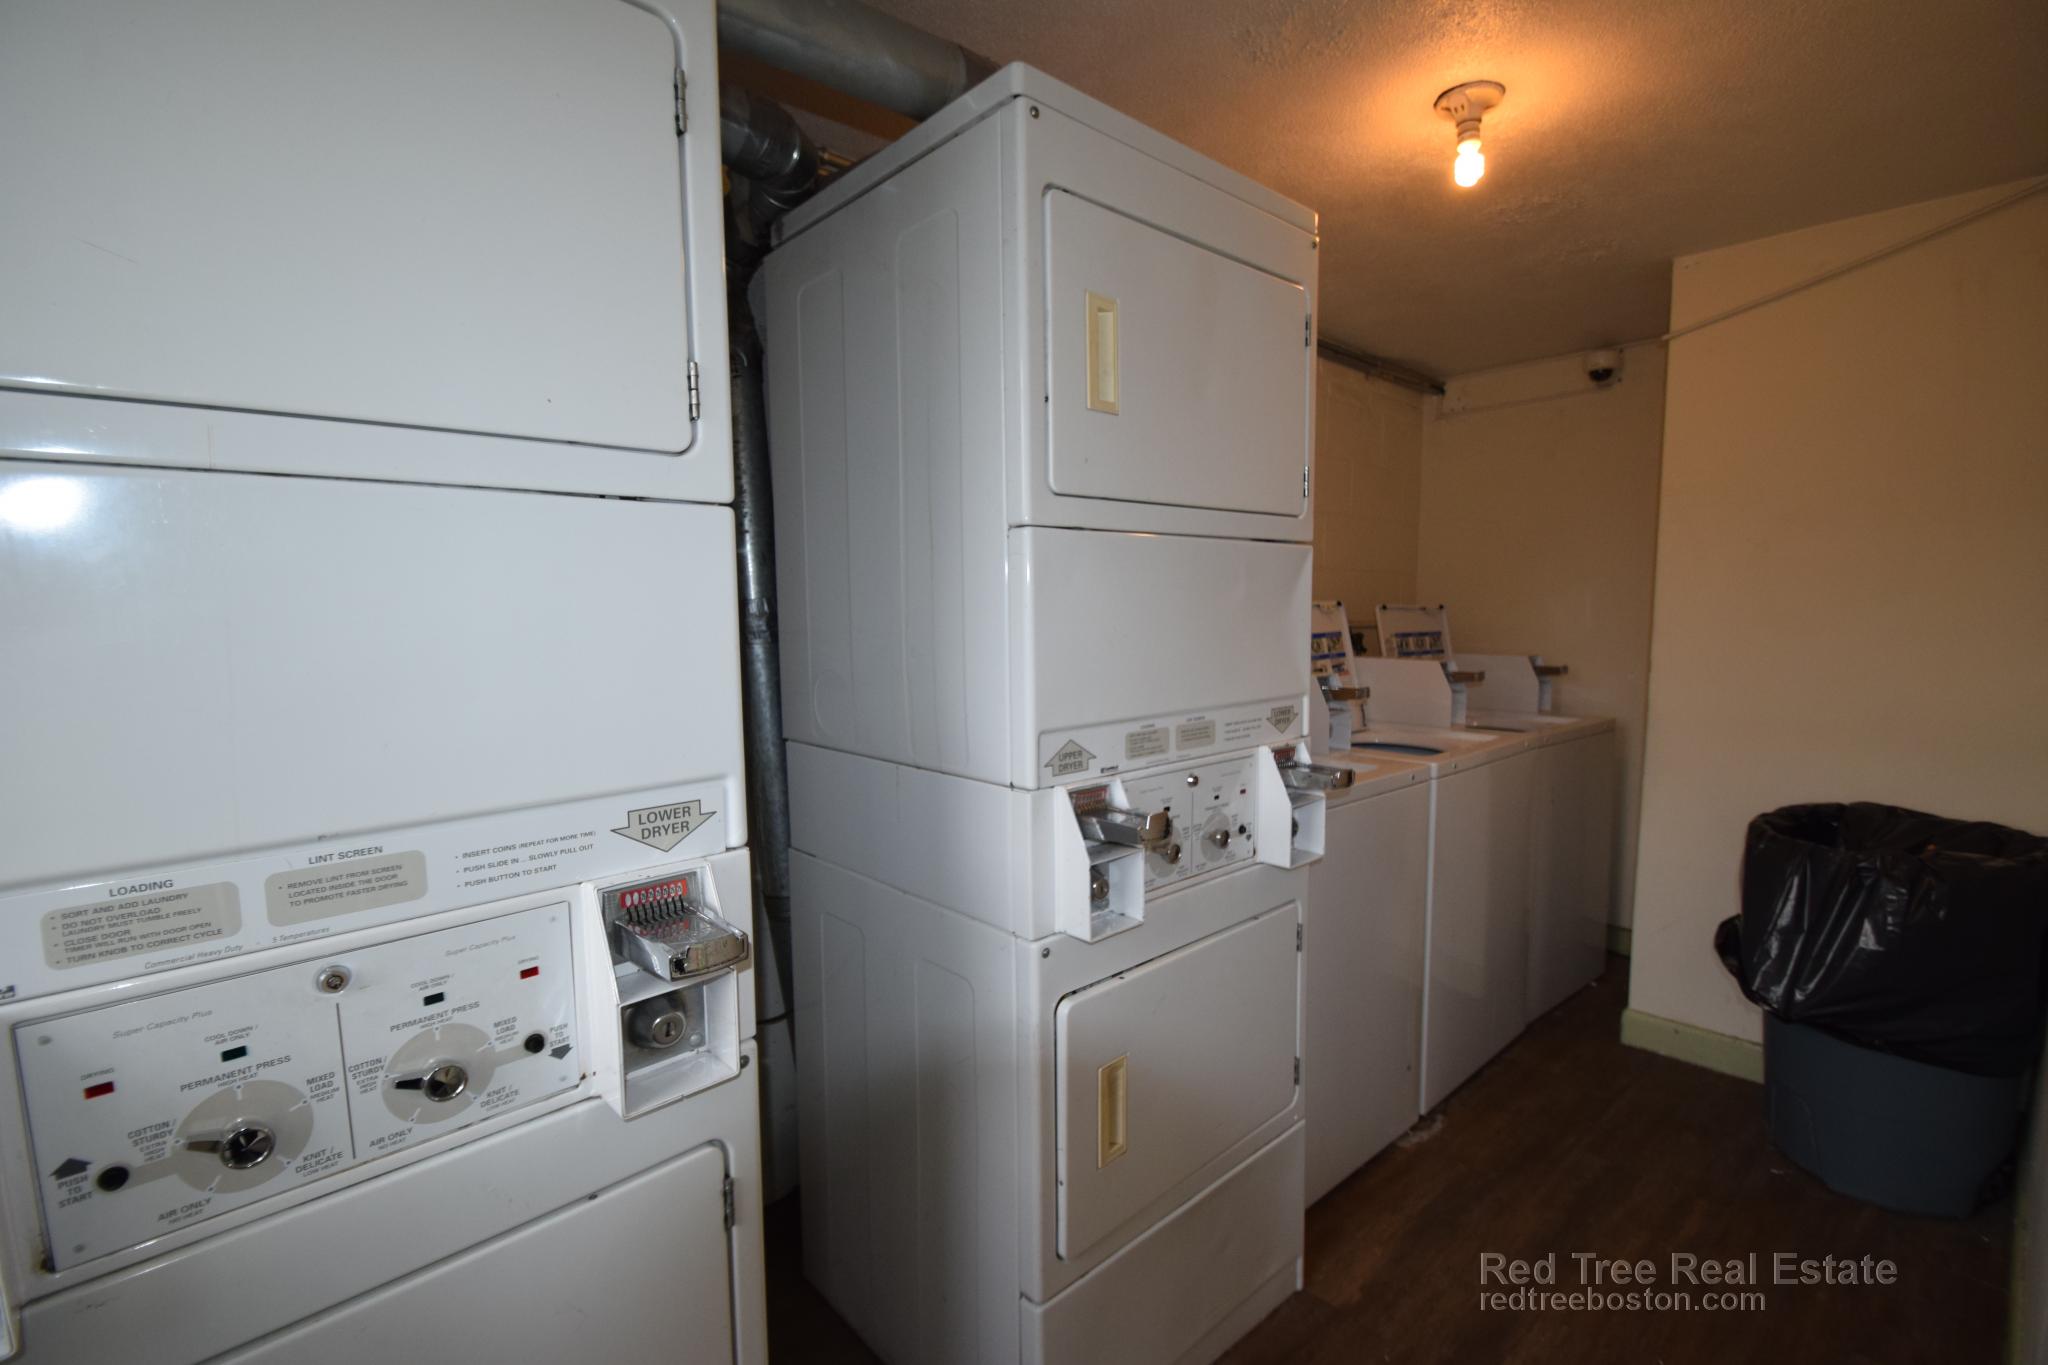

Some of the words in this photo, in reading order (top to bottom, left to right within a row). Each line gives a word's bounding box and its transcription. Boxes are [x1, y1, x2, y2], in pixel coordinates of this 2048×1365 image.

[1059, 751, 1082, 761] UPPER
[1059, 761, 1083, 772] DRYER
[639, 806, 691, 825] LOWER
[641, 821, 690, 840] DRYER
[309, 854, 334, 865] LINT
[338, 846, 383, 860] SCREEN
[462, 849, 490, 858] INSERT
[492, 845, 516, 853] COINS
[464, 864, 485, 873] PUSH
[488, 860, 508, 868] SLIDE
[288, 878, 323, 889] REMOVE
[325, 875, 344, 883] LINT
[346, 870, 369, 879] FROM
[371, 865, 402, 874] SCREEN
[465, 878, 486, 887] PUSH
[489, 872, 520, 882] BUTTON
[535, 865, 556, 874] START
[109, 880, 173, 897] LOADING
[289, 887, 326, 898] LOCATED
[329, 882, 355, 891] INSIDE
[375, 874, 398, 883] DOOR
[304, 893, 344, 904] PROMOTE
[346, 887, 376, 896] FASTER
[378, 881, 408, 891] DRYING
[61, 909, 88, 920] SORT
[93, 905, 114, 915] AND
[118, 901, 138, 910] ADD
[142, 893, 188, 906] LAUNDRY
[62, 921, 77, 930] DO
[81, 917, 102, 927] NOT
[106, 907, 161, 922] OVERLOAD
[62, 925, 104, 937] LAUNDRY
[108, 919, 133, 928] MUST
[136, 914, 170, 924] TUMBLE
[173, 907, 202, 917] FREELY
[64, 936, 97, 947] CLOSE
[101, 930, 130, 940] DOOR
[65, 943, 92, 953] TIMER
[95, 939, 115, 948] WILL
[118, 936, 136, 944] RUN
[140, 931, 161, 940] WITH
[163, 926, 187, 935] DOOR
[189, 922, 211, 930] OPEN
[67, 953, 96, 964] TURN
[99, 947, 127, 958] KNOB
[131, 943, 144, 951] TO
[147, 934, 190, 949] CORRECT
[193, 929, 222, 939] CYCLE
[145, 953, 195, 969] Commercial
[198, 950, 223, 960] Heavy
[224, 945, 243, 954] Duty
[113, 1026, 144, 1038] Super
[146, 1016, 188, 1030] Capacity
[192, 1010, 213, 1019] Plus
[390, 1010, 449, 1032] PERMANENT
[451, 1001, 480, 1015] PRESS
[494, 1017, 517, 1028] MIXED
[496, 1025, 515, 1035] LOAD
[550, 1023, 568, 1033] PUSH
[550, 1036, 569, 1047] START
[180, 1065, 251, 1092] PERMANENT
[256, 1055, 291, 1071] PRESS
[348, 1058, 381, 1072] COTTON
[352, 1065, 384, 1079] STURDY
[306, 1072, 335, 1086] MIXED
[310, 1081, 333, 1093] LOAD
[480, 1089, 519, 1108] DELICATE
[487, 1087, 506, 1097] KNIT
[128, 1121, 170, 1139] COTTON
[132, 1129, 174, 1147] STURDY
[369, 1137, 385, 1147] AIR
[388, 1127, 413, 1140] ONLY
[296, 1152, 344, 1174] DELICATE
[303, 1149, 326, 1162] KNIT
[58, 1174, 88, 1189] PUSH
[59, 1192, 92, 1209] START
[67, 1187, 81, 1196] TO
[158, 1210, 176, 1221] AIR
[180, 1198, 212, 1213] ONLY
